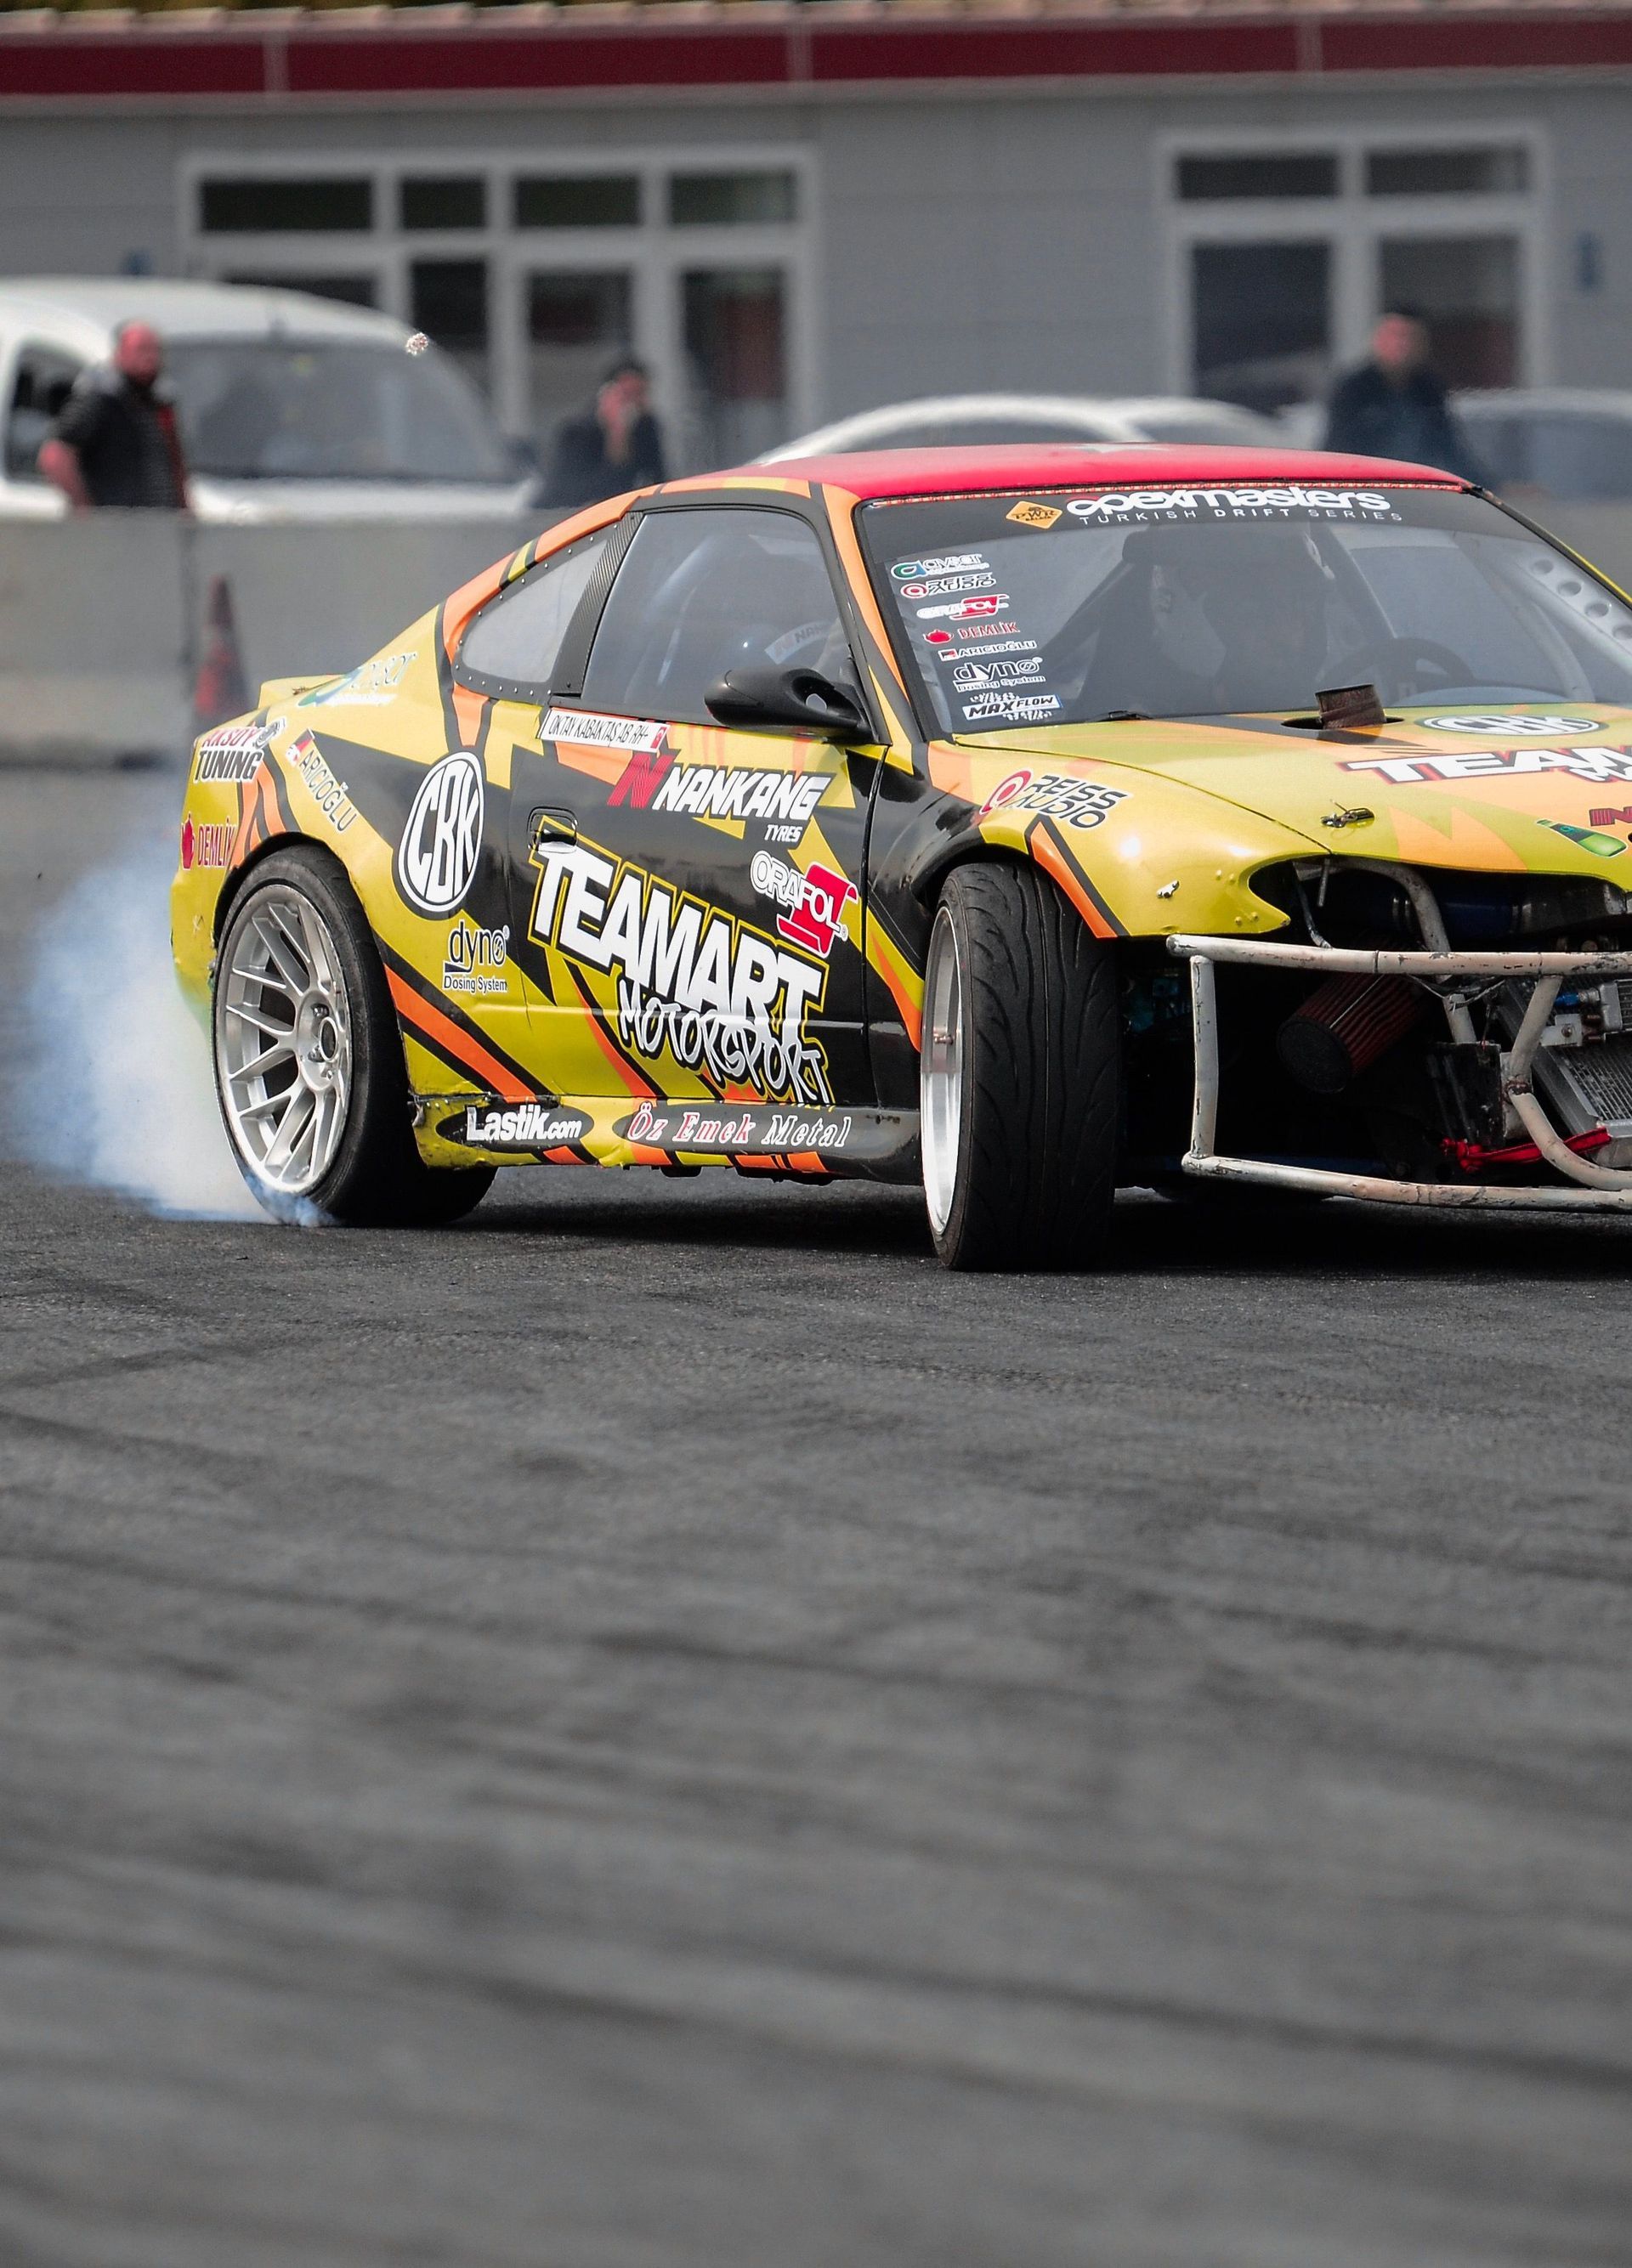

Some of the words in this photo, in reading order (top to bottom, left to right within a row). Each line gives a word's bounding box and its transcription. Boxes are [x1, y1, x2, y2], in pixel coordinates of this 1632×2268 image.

[1067, 487, 1391, 516] apexmasters
[1080, 510, 1197, 525] TURKISH
[1214, 508, 1290, 518] DRIFT
[1308, 509, 1402, 521] SERIES
[955, 661, 1039, 682] dyno
[548, 715, 575, 735] OKTAY
[617, 723, 634, 744] AB
[194, 749, 263, 781] TUNING
[652, 766, 832, 821] NANKANG
[1023, 774, 1128, 810] REISS
[1003, 793, 1106, 828] AUDIO
[415, 761, 482, 907] CBK
[764, 823, 803, 843] TYRES
[751, 851, 841, 930] ORAFOL
[445, 921, 506, 972] dyno
[535, 844, 824, 1047] TEAMART
[444, 976, 475, 993] Dosing
[478, 976, 507, 993] System
[619, 978, 830, 1104] MOTORSPORT
[467, 1104, 582, 1141] Lastik.com
[627, 1101, 668, 1141] Öz
[673, 1113, 755, 1144] Emek
[762, 1114, 852, 1148] Metal
